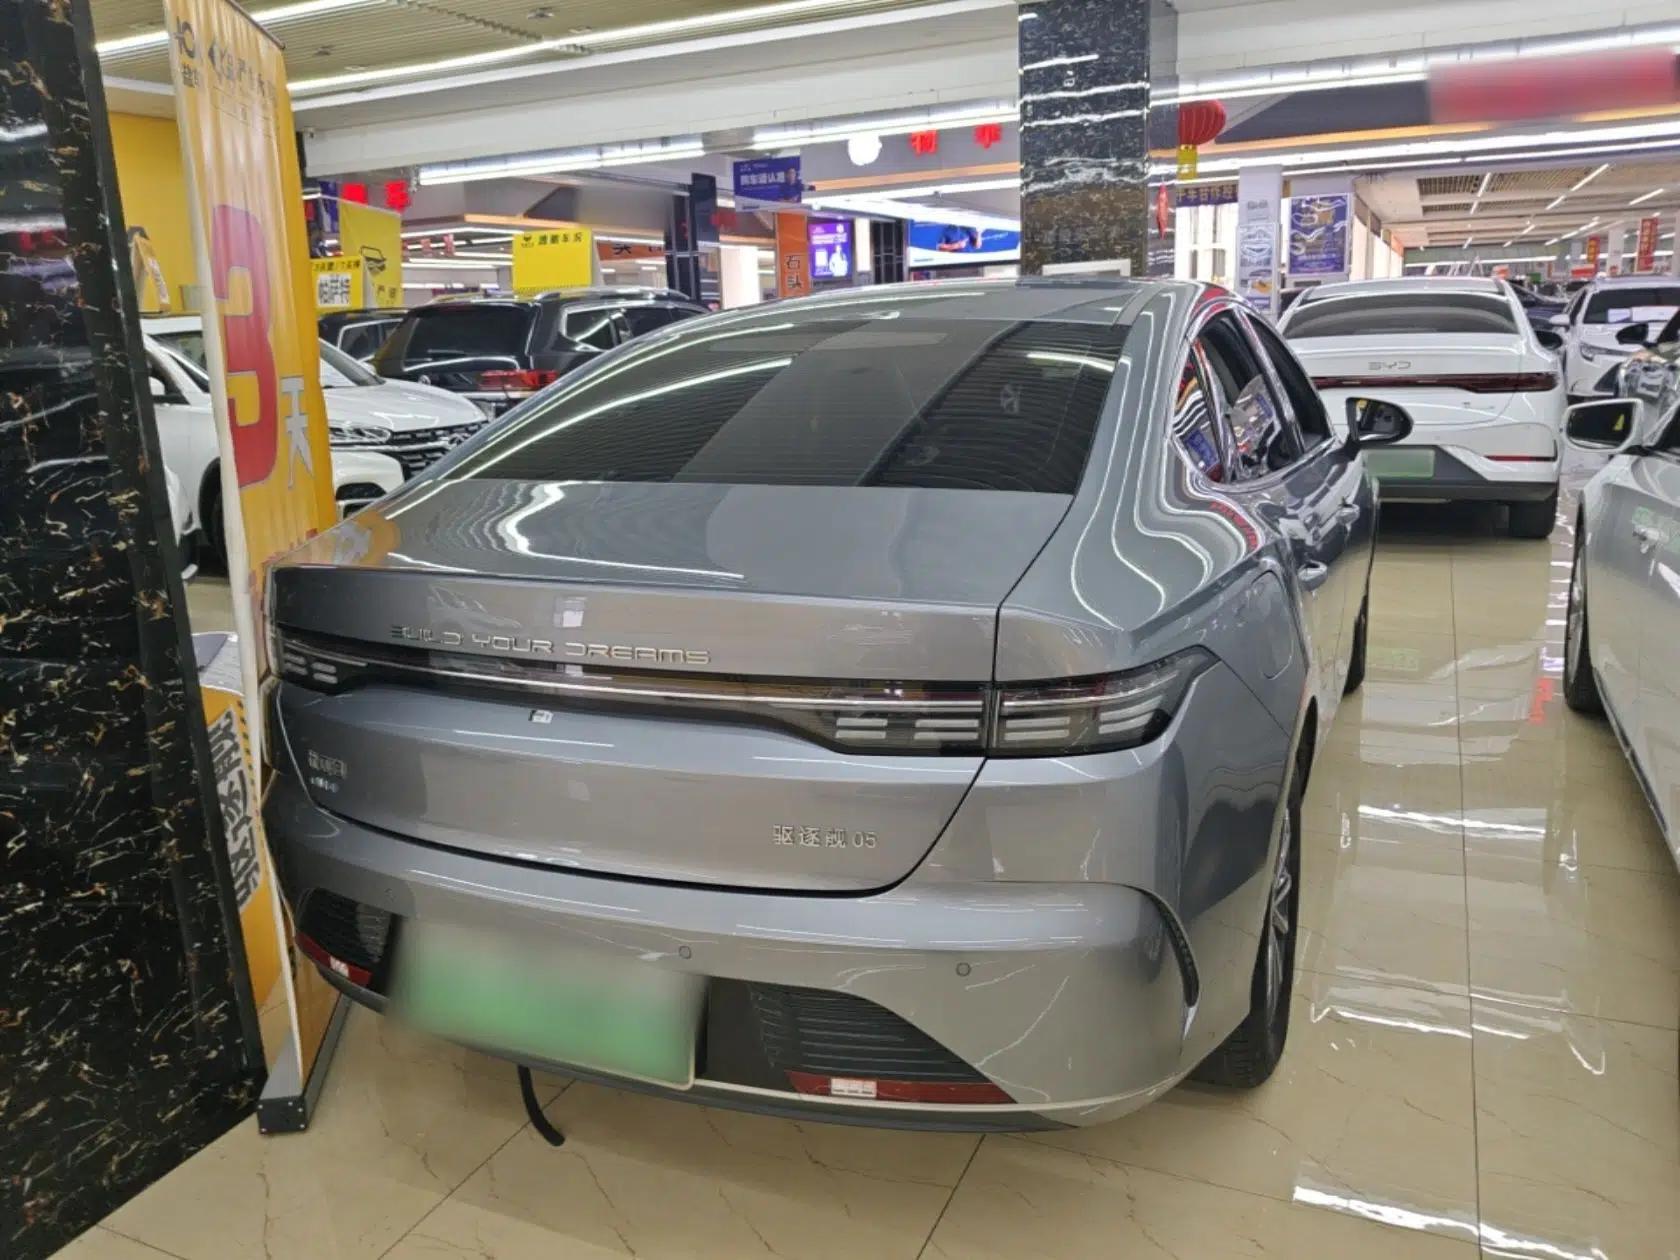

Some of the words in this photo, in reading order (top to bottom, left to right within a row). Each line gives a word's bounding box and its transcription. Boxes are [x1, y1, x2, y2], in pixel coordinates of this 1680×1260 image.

[1368, 361, 1411, 371] BYD
[472, 633, 554, 654] YOUR
[564, 641, 712, 665] DREAMS
[852, 831, 877, 849] 05
